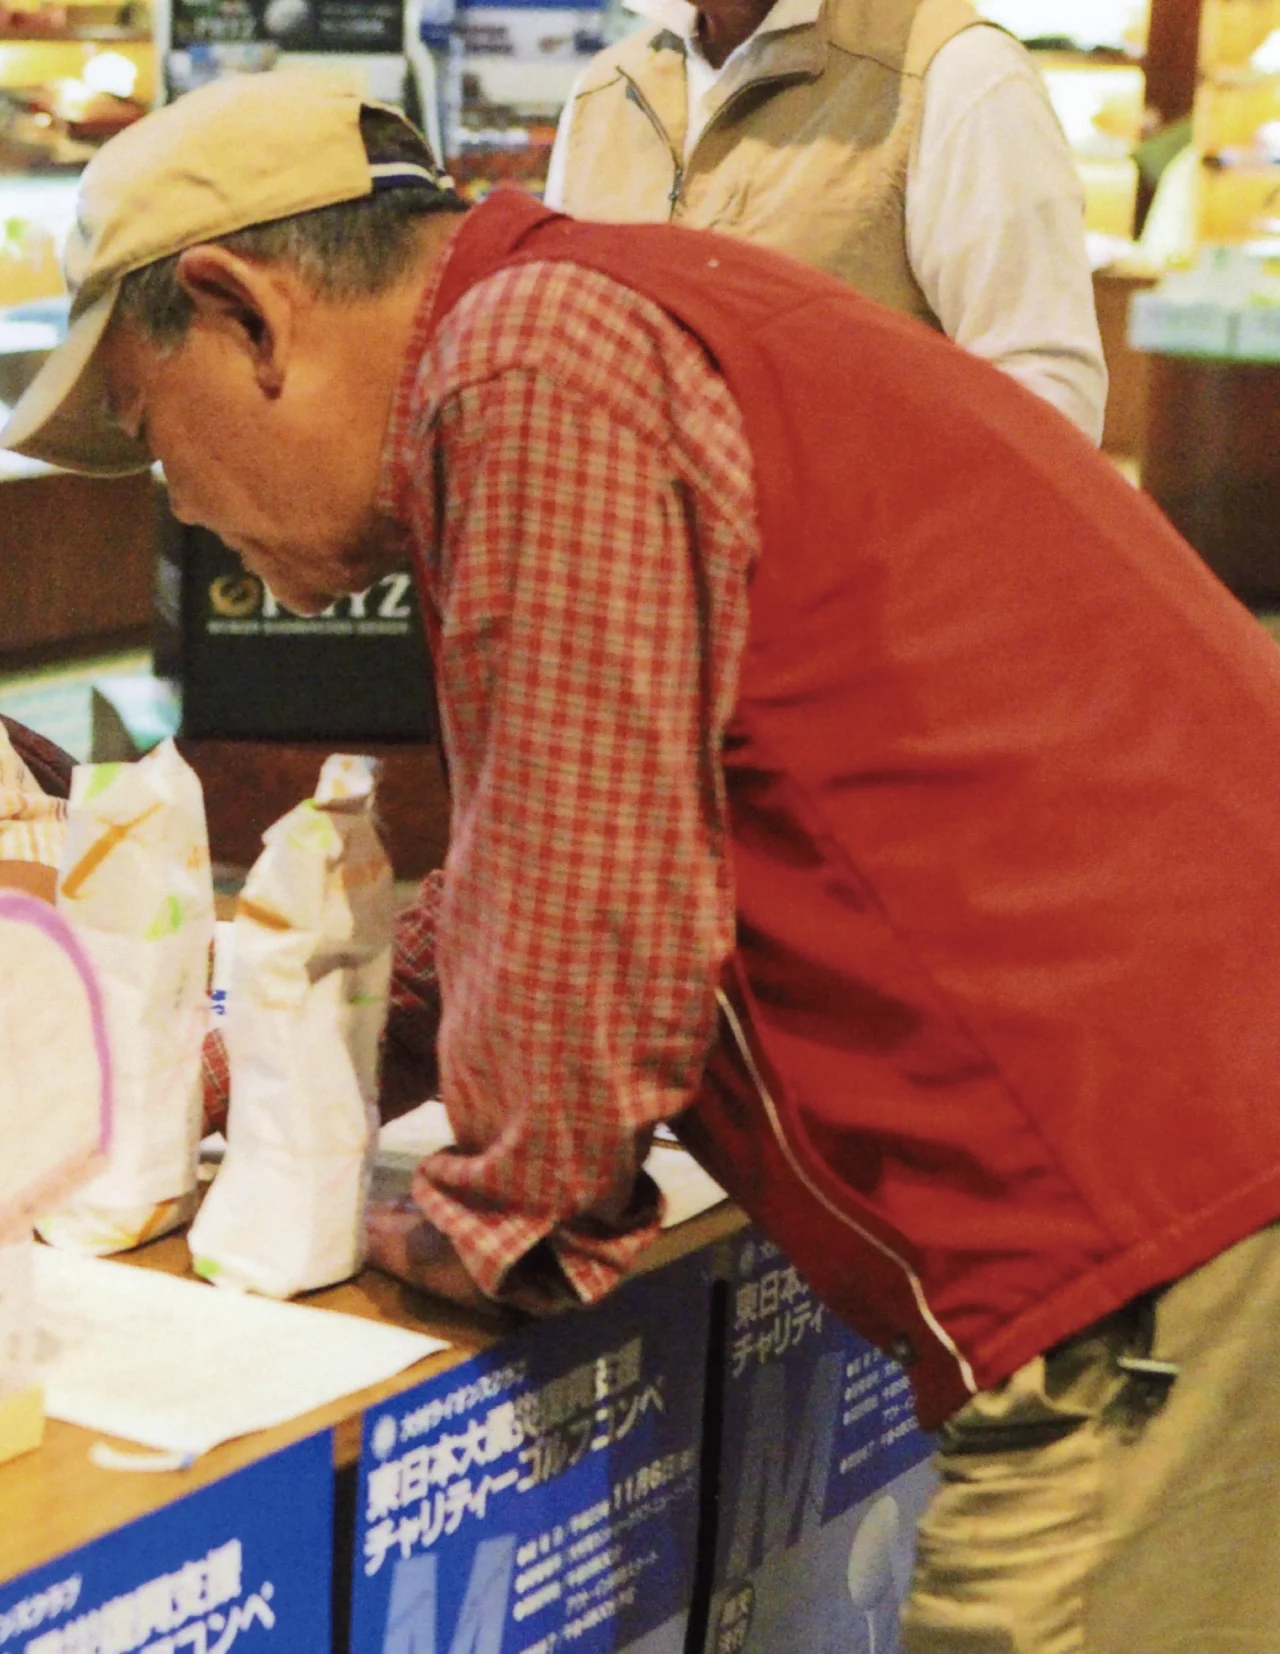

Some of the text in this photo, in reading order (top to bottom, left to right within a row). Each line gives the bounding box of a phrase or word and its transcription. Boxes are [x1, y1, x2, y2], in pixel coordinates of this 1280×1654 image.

[734, 1265, 810, 1331] 東日本
[732, 1302, 828, 1378] チャリティ
